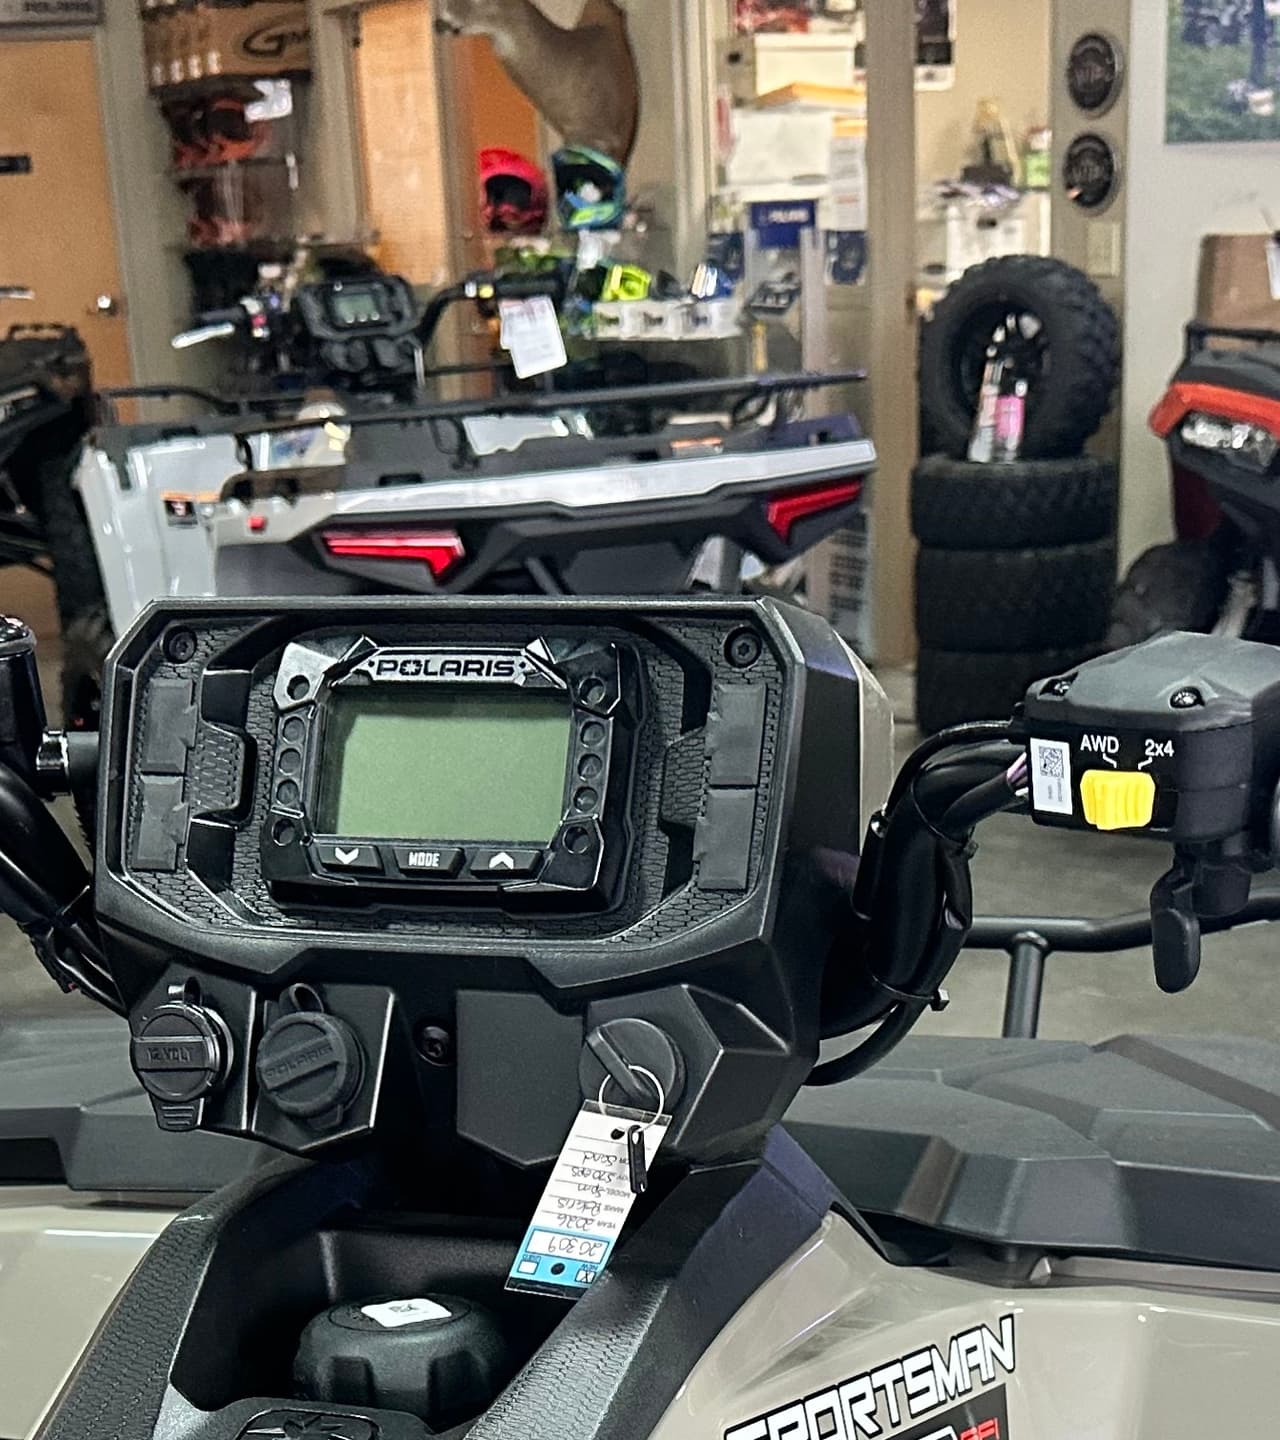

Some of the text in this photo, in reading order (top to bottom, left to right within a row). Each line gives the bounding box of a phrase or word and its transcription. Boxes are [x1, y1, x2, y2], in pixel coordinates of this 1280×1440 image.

[376, 659, 515, 677] POLARIS
[1080, 734, 1120, 754] AWD
[1144, 738, 1175, 757] 2x4
[408, 851, 441, 868] MODE
